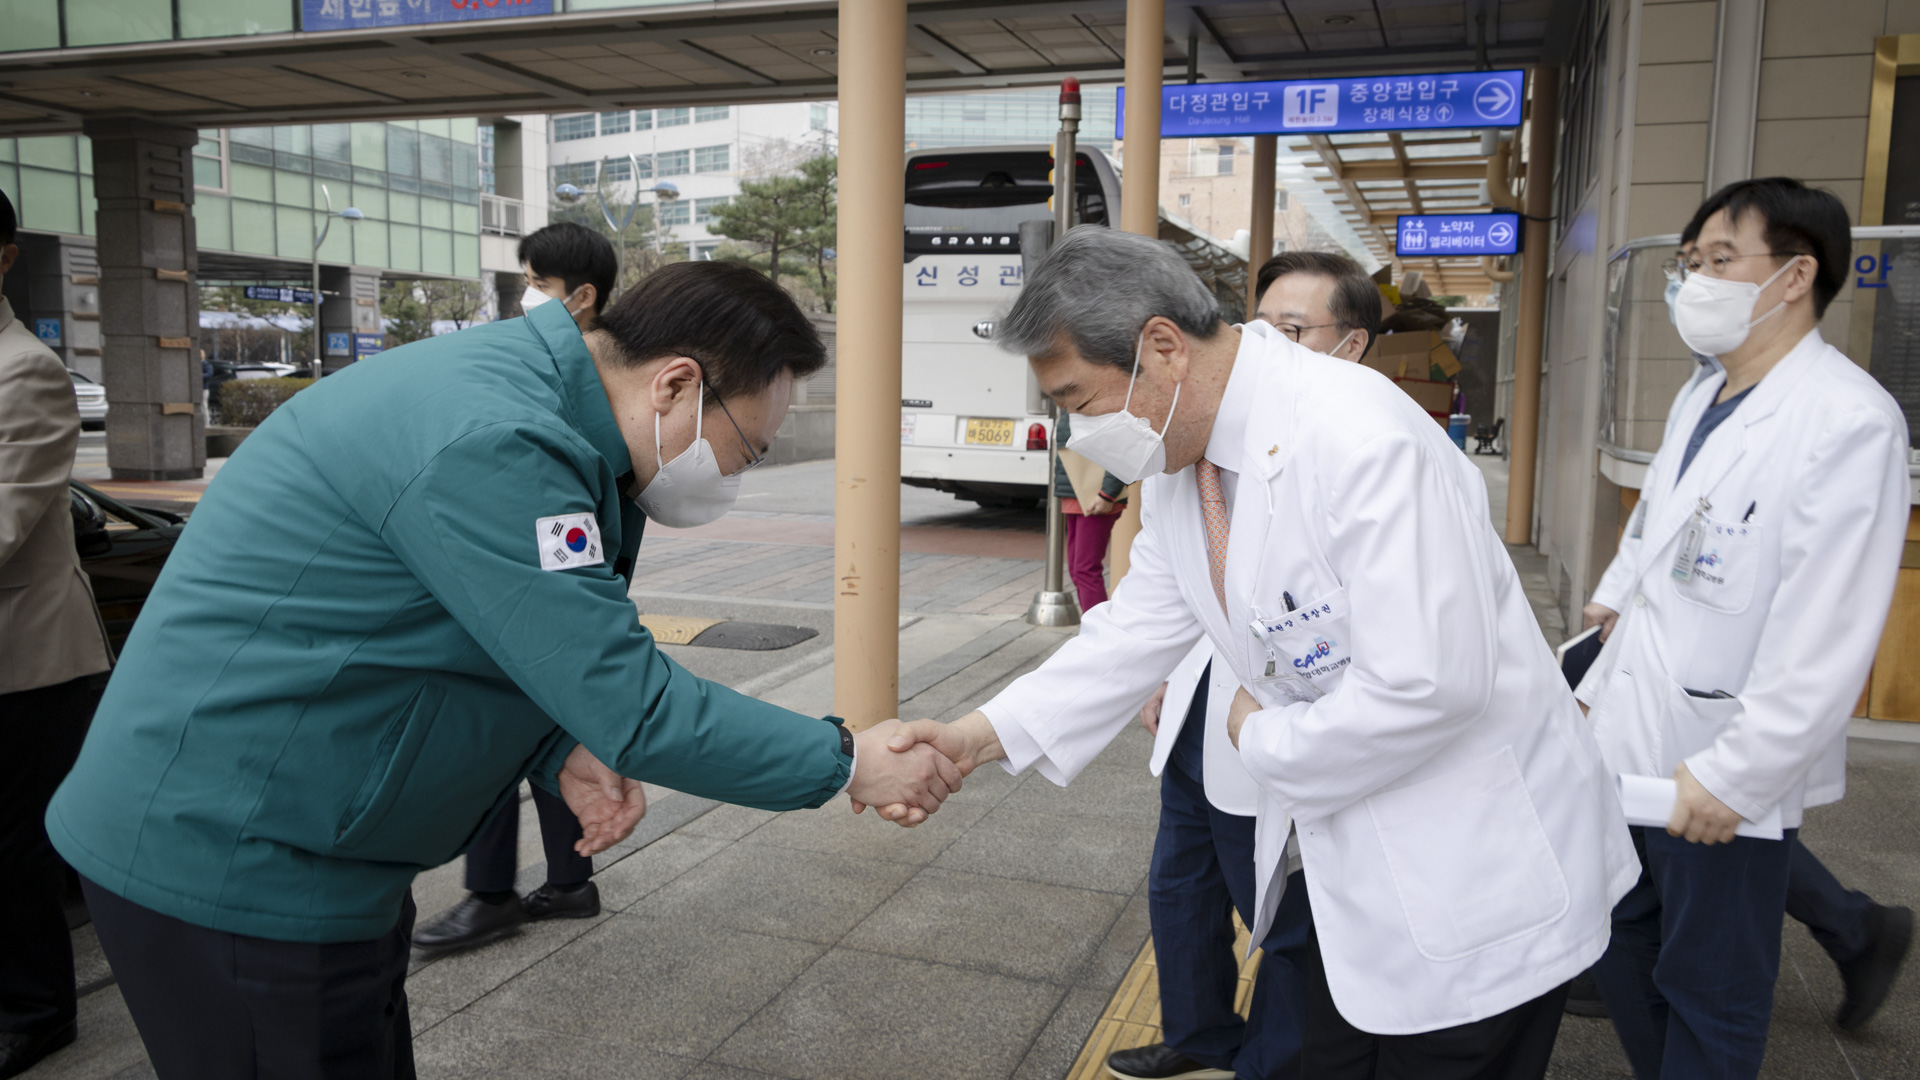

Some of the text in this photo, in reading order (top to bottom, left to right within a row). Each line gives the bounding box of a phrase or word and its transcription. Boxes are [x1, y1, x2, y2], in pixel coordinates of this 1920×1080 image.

[1350, 79, 1460, 103] 중앙관입구
[1169, 91, 1270, 113] 다정관입구
[1296, 88, 1326, 114] 1F
[1363, 105, 1431, 123] 장례식장
[1440, 220, 1475, 233] 노약자
[931, 236, 1011, 245] GRANB
[1429, 235, 1485, 248] 엘리베이터
[1855, 253, 1893, 289] 안
[976, 321, 993, 337] KI
[978, 428, 1011, 442] 5069
